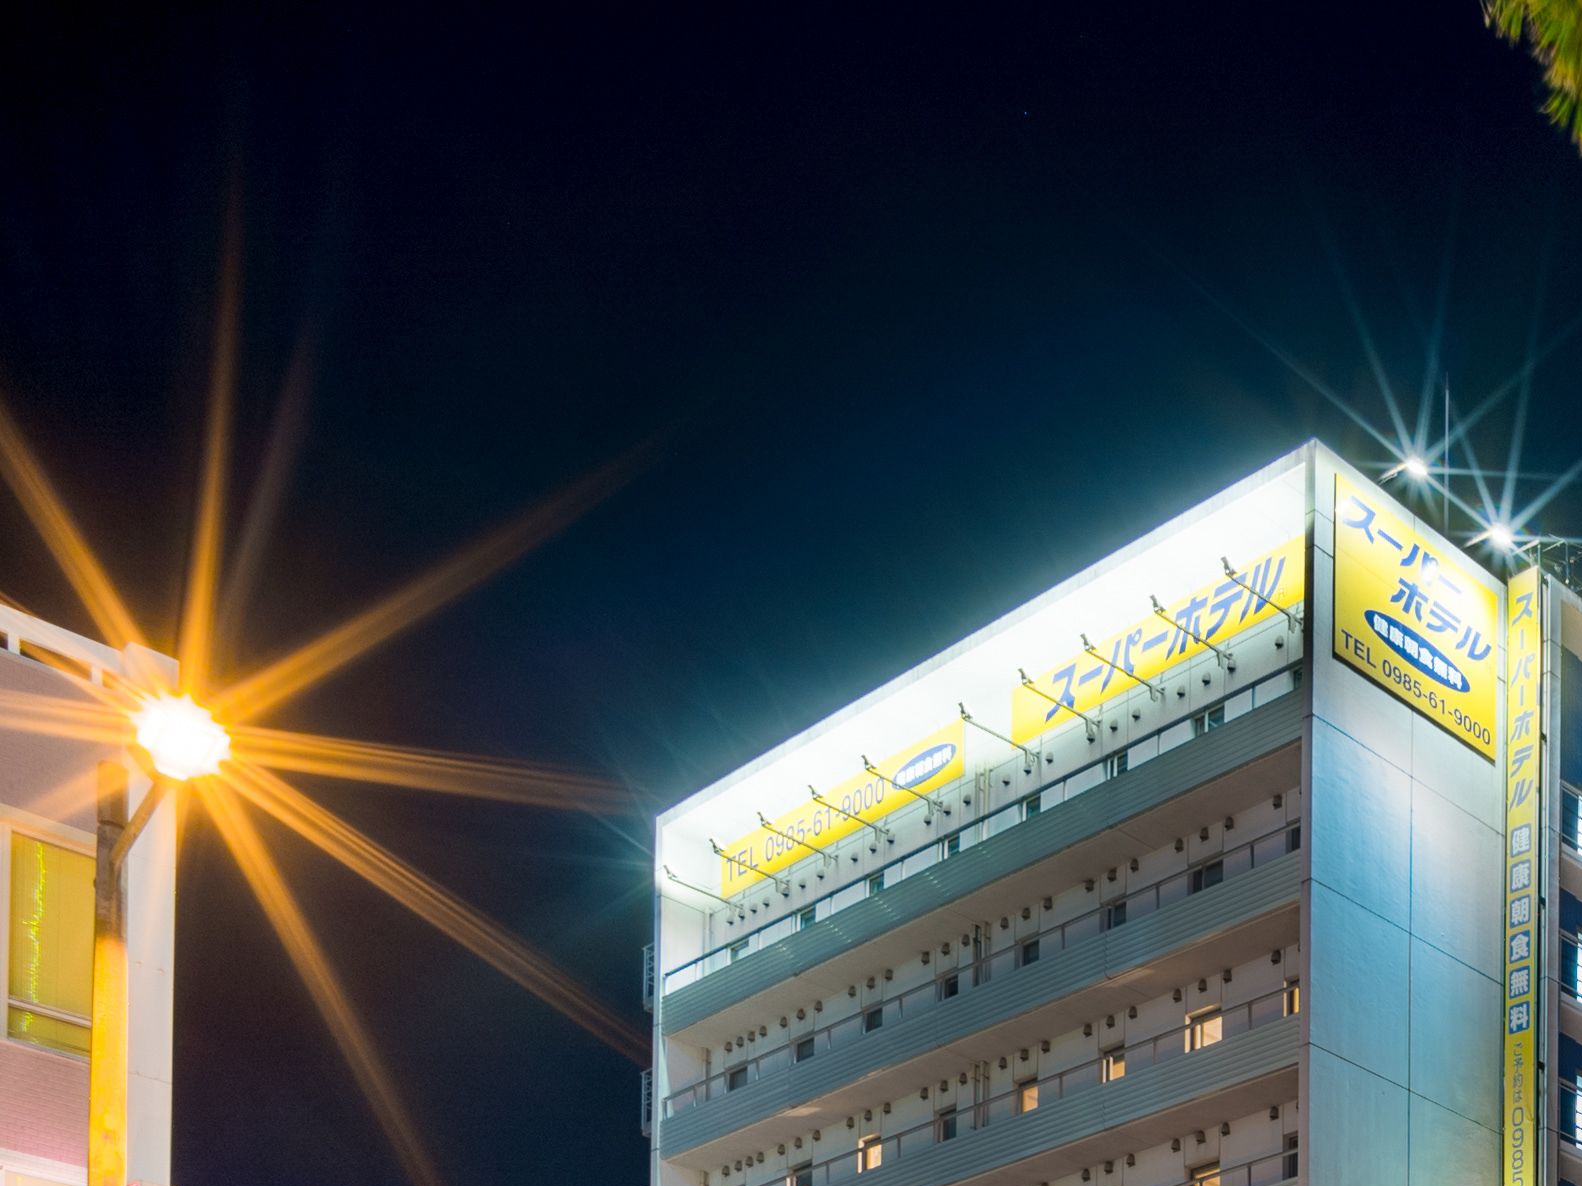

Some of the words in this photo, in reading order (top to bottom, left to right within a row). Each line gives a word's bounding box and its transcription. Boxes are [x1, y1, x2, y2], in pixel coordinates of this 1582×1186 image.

[1343, 493, 1462, 594] スーパー
[1045, 556, 1286, 723] スーパーホテル
[1390, 577, 1491, 661] ホテル
[1341, 629, 1376, 669] TEL
[1382, 661, 1491, 745] 0985-61-9000
[1509, 591, 1535, 812] スーパーホテル
[726, 847, 760, 882] TEL
[764, 777, 886, 862] 0985-61-9000
[1509, 825, 1531, 1033] 健康朝食無料
